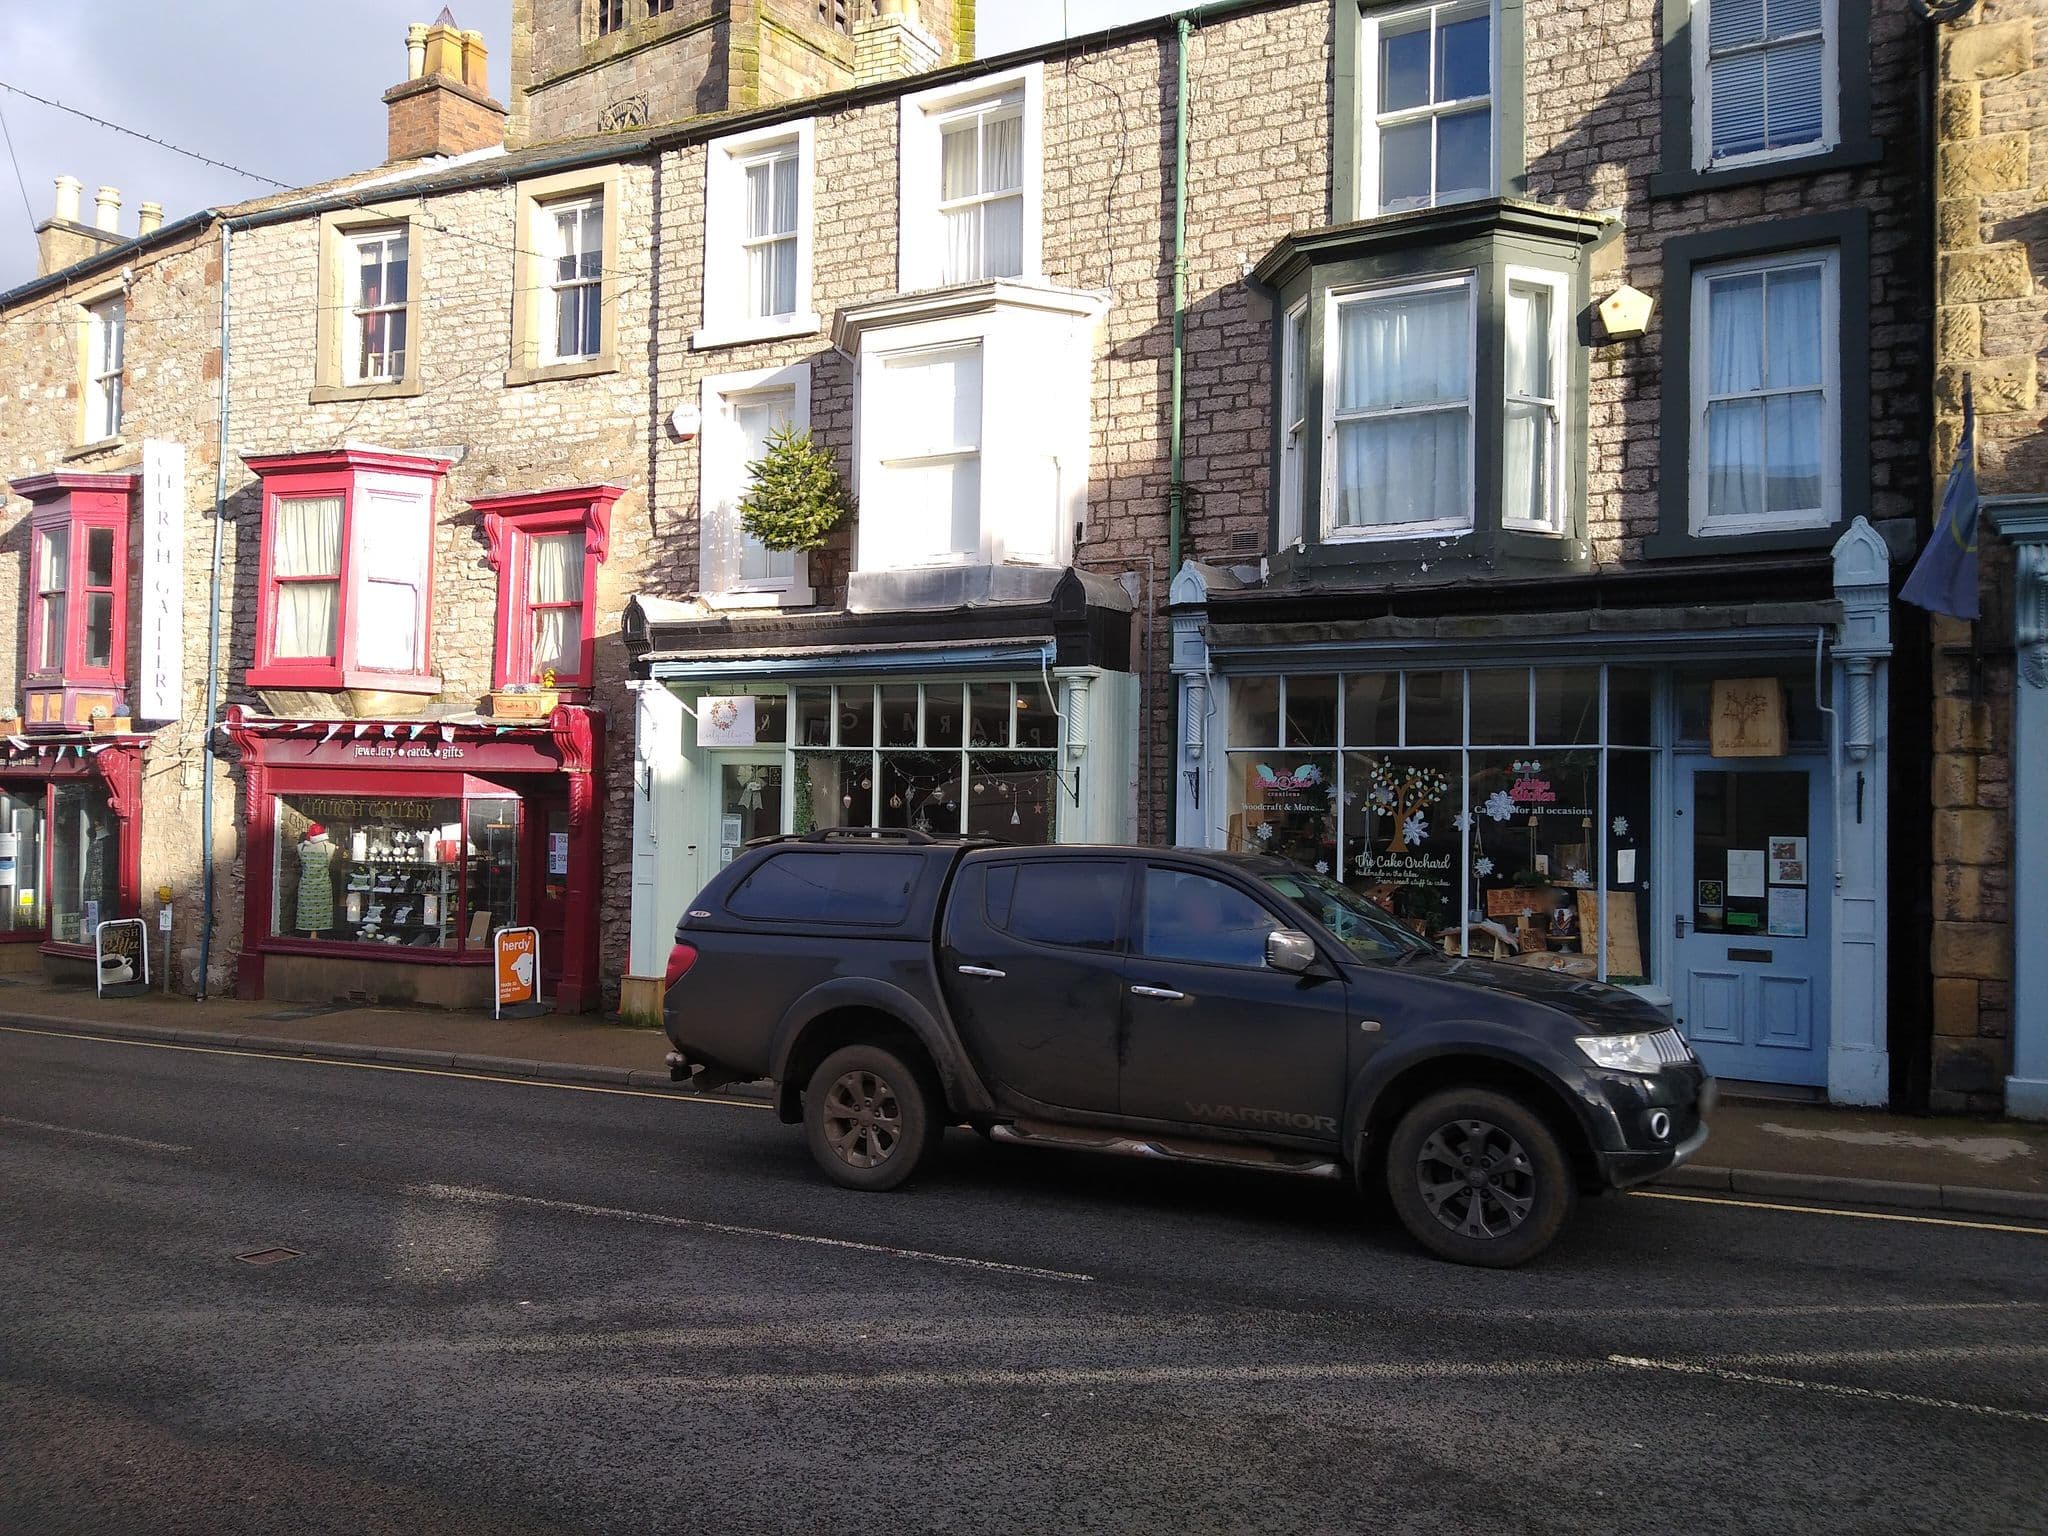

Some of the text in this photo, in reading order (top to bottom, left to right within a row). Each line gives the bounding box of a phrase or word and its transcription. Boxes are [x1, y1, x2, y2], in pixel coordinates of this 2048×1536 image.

[354, 744, 464, 759] jewellery cards gifts
[302, 802, 434, 818] CHURCH GALLERY
[1242, 803, 1282, 811] Woodcraft
[1284, 803, 1291, 811] &
[1515, 806, 1592, 815] for all occasions
[1355, 852, 1451, 869] The Cake Orchard
[1410, 879, 1426, 888] stuff
[502, 938, 530, 951] herdy
[1185, 1102, 1337, 1134] WARRIOR
